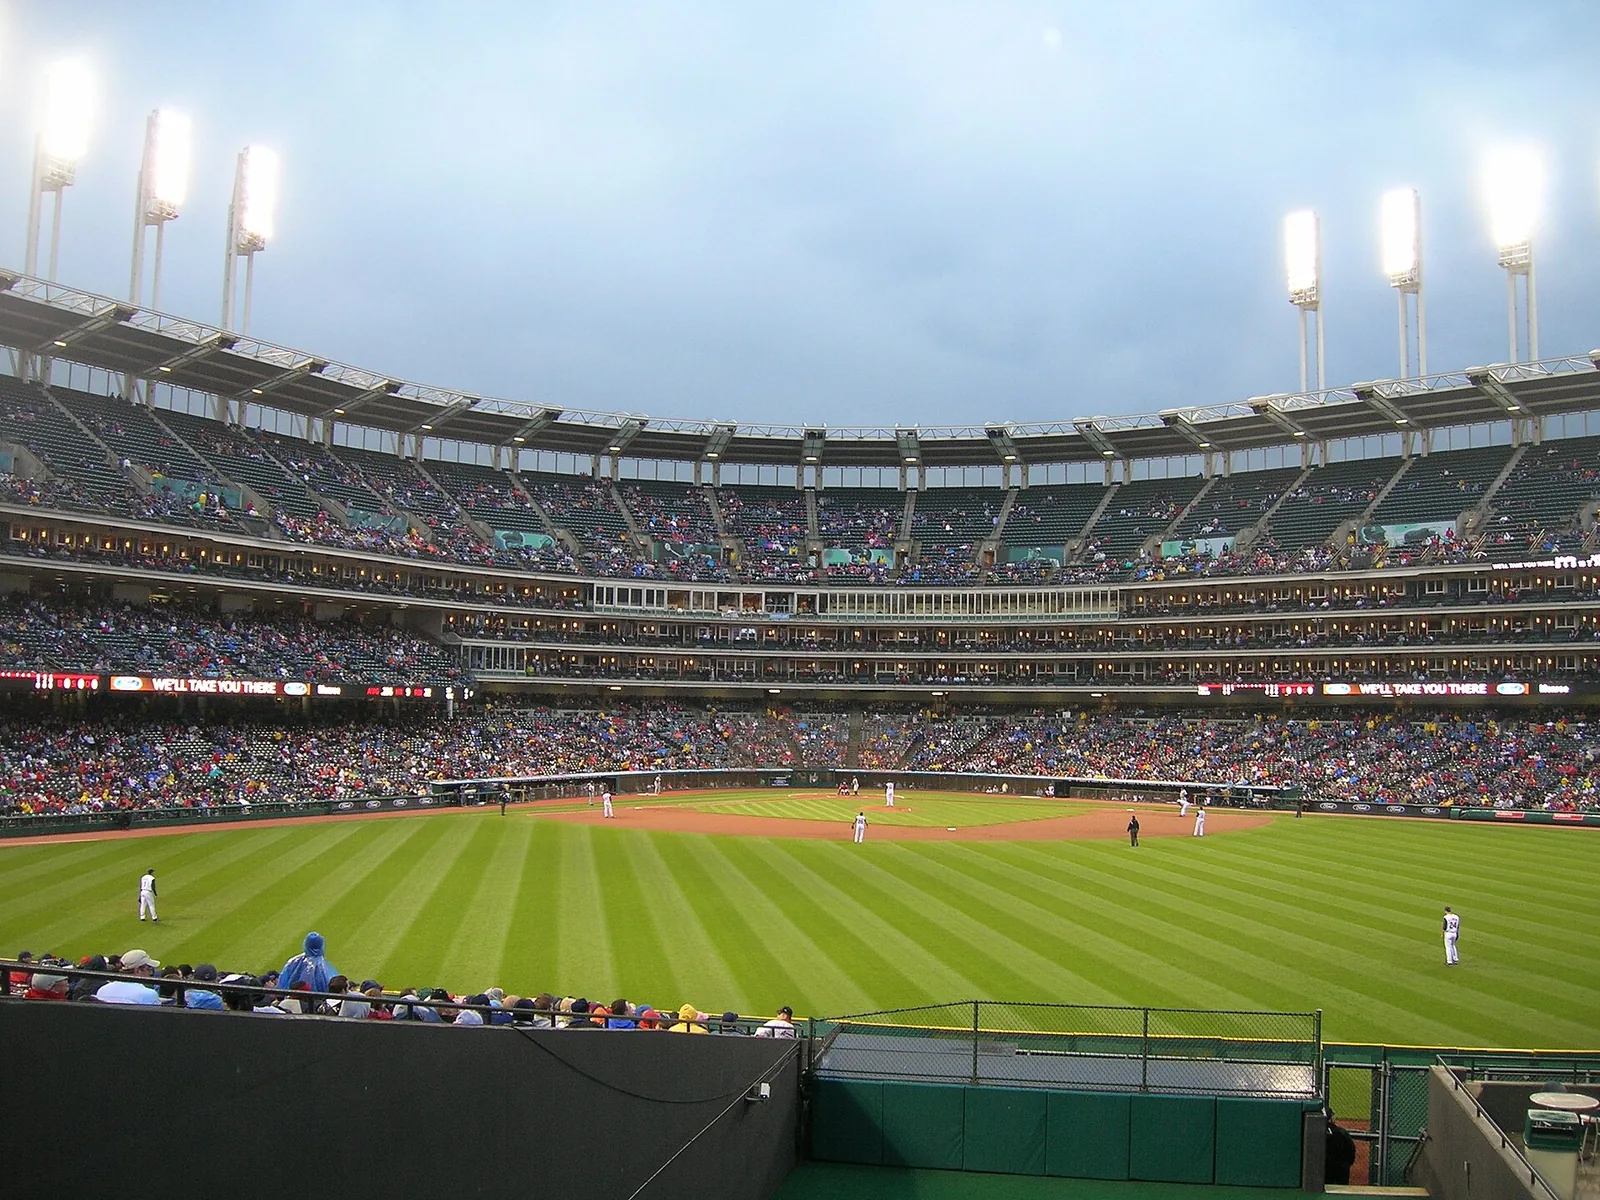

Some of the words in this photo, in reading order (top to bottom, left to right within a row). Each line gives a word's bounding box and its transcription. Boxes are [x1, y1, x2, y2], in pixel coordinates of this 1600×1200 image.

[152, 678, 188, 691] WE'LL
[188, 679, 217, 693] TAKE
[218, 680, 241, 693] YOU
[241, 681, 277, 694] THERE
[1359, 683, 1393, 695] WE'LL
[1393, 683, 1422, 695] TAKE
[1422, 684, 1447, 695] YOU
[1448, 683, 1488, 695] THERE
